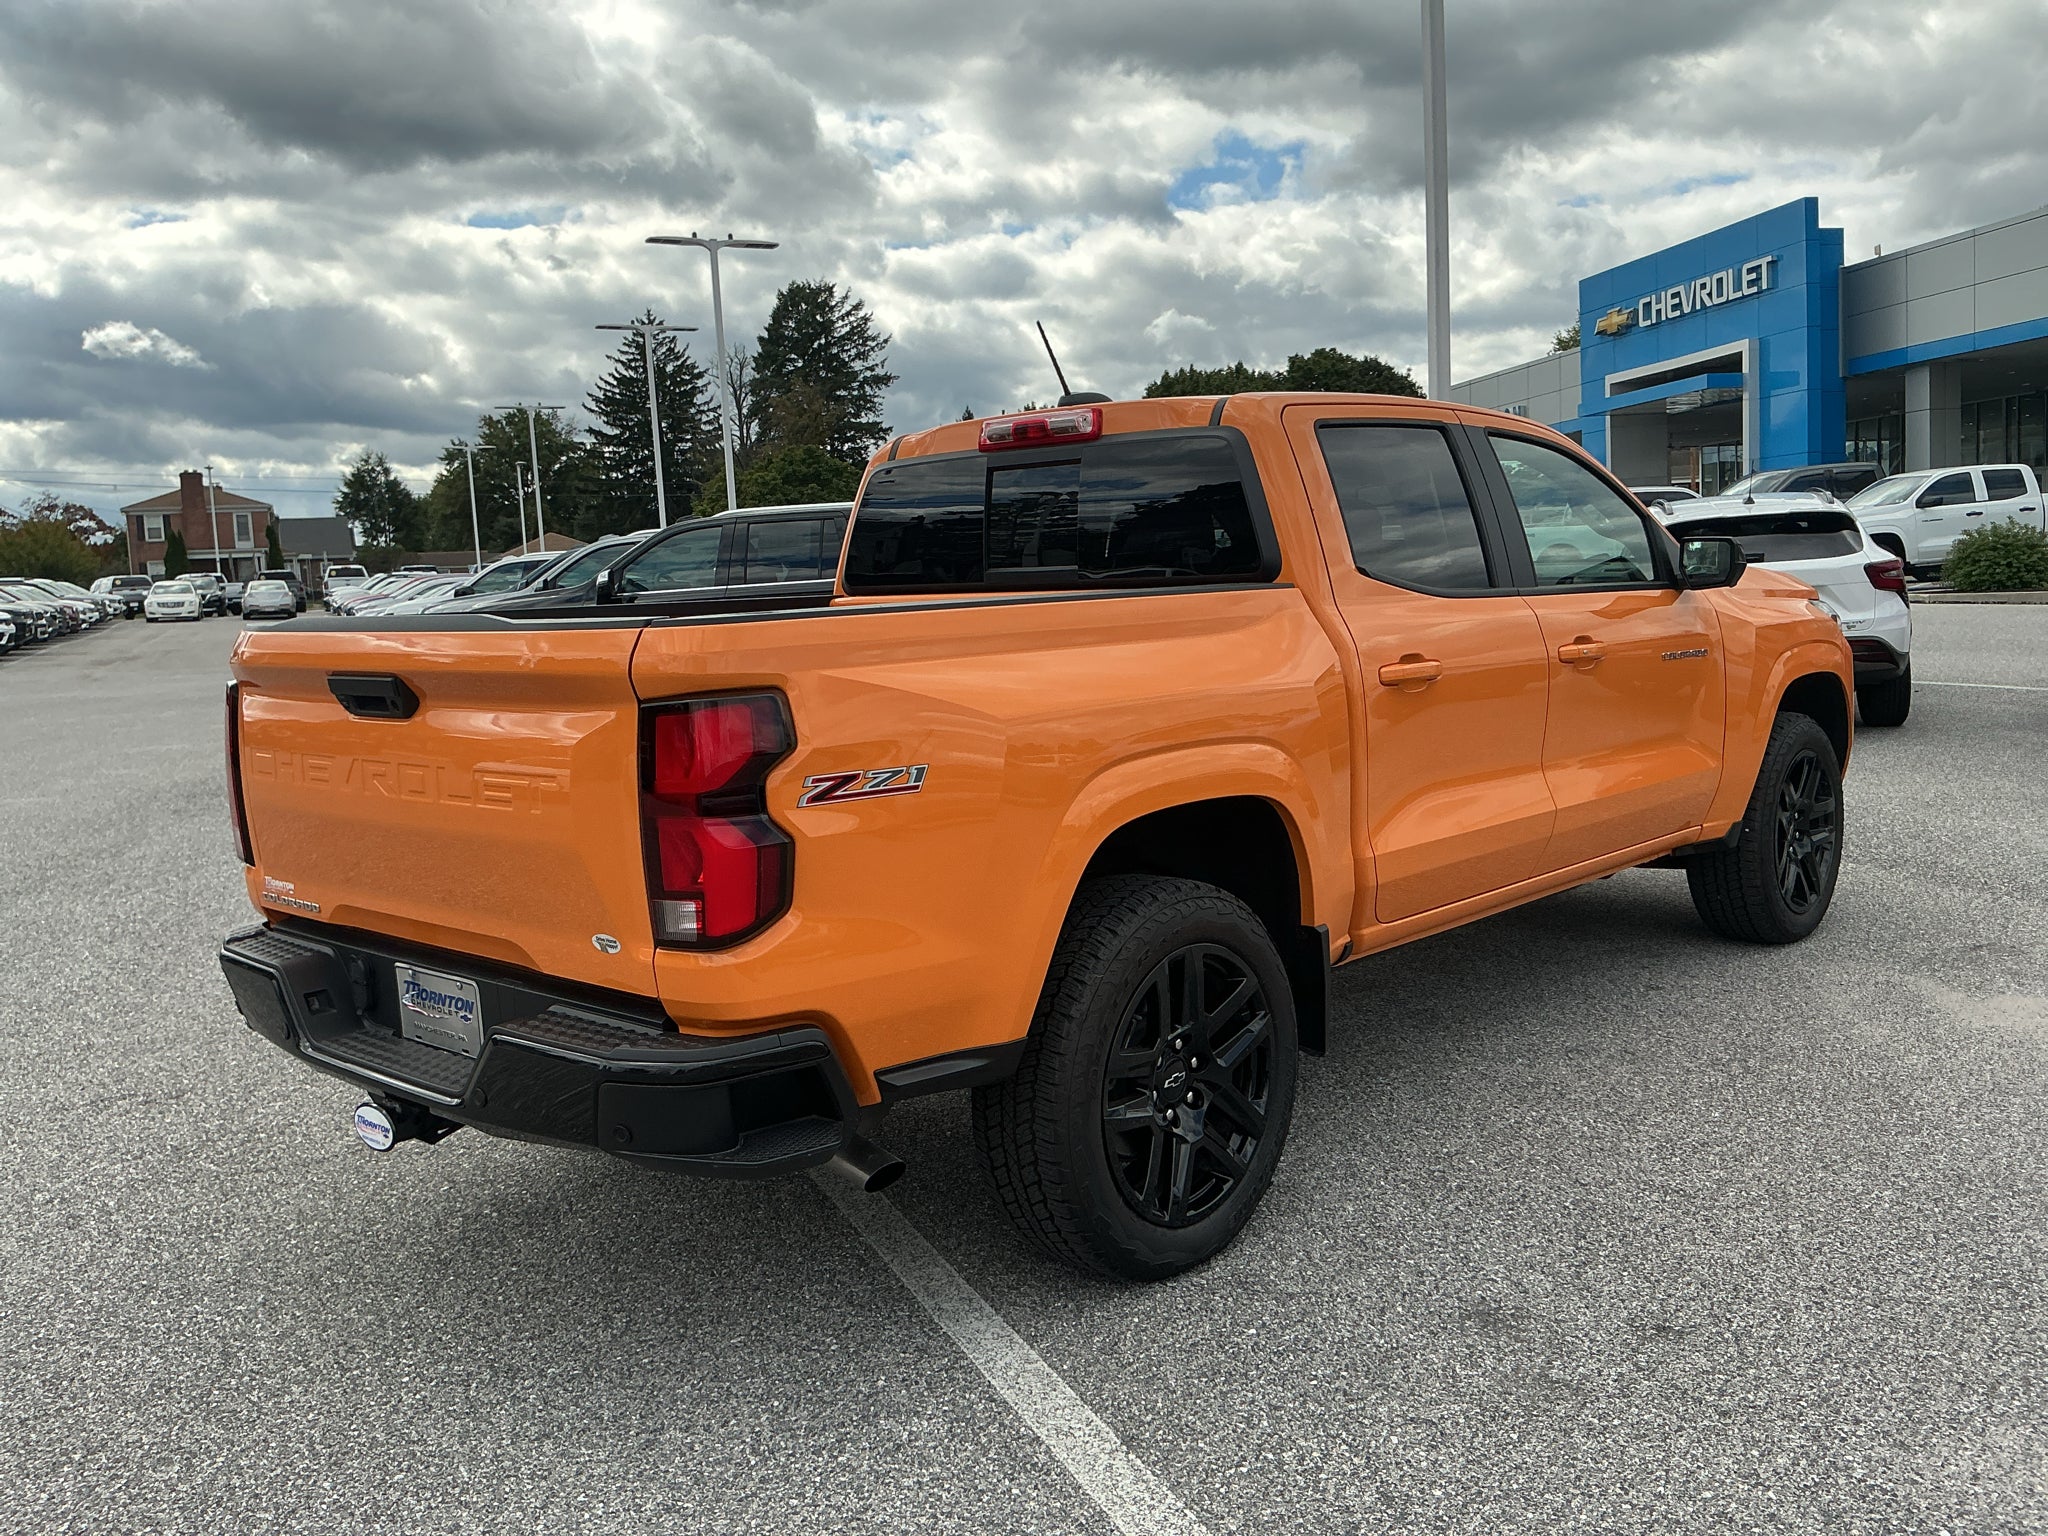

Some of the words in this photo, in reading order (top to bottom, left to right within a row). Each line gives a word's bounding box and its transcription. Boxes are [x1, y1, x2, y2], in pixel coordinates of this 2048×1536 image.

[1638, 255, 1775, 328] CHEVROLET
[251, 747, 570, 815] CHEVROLET
[262, 891, 320, 912] COLORADO
[404, 980, 474, 1014] THORNTON
[411, 999, 460, 1017] CHEVROLET
[357, 1114, 391, 1134] THORNTON
